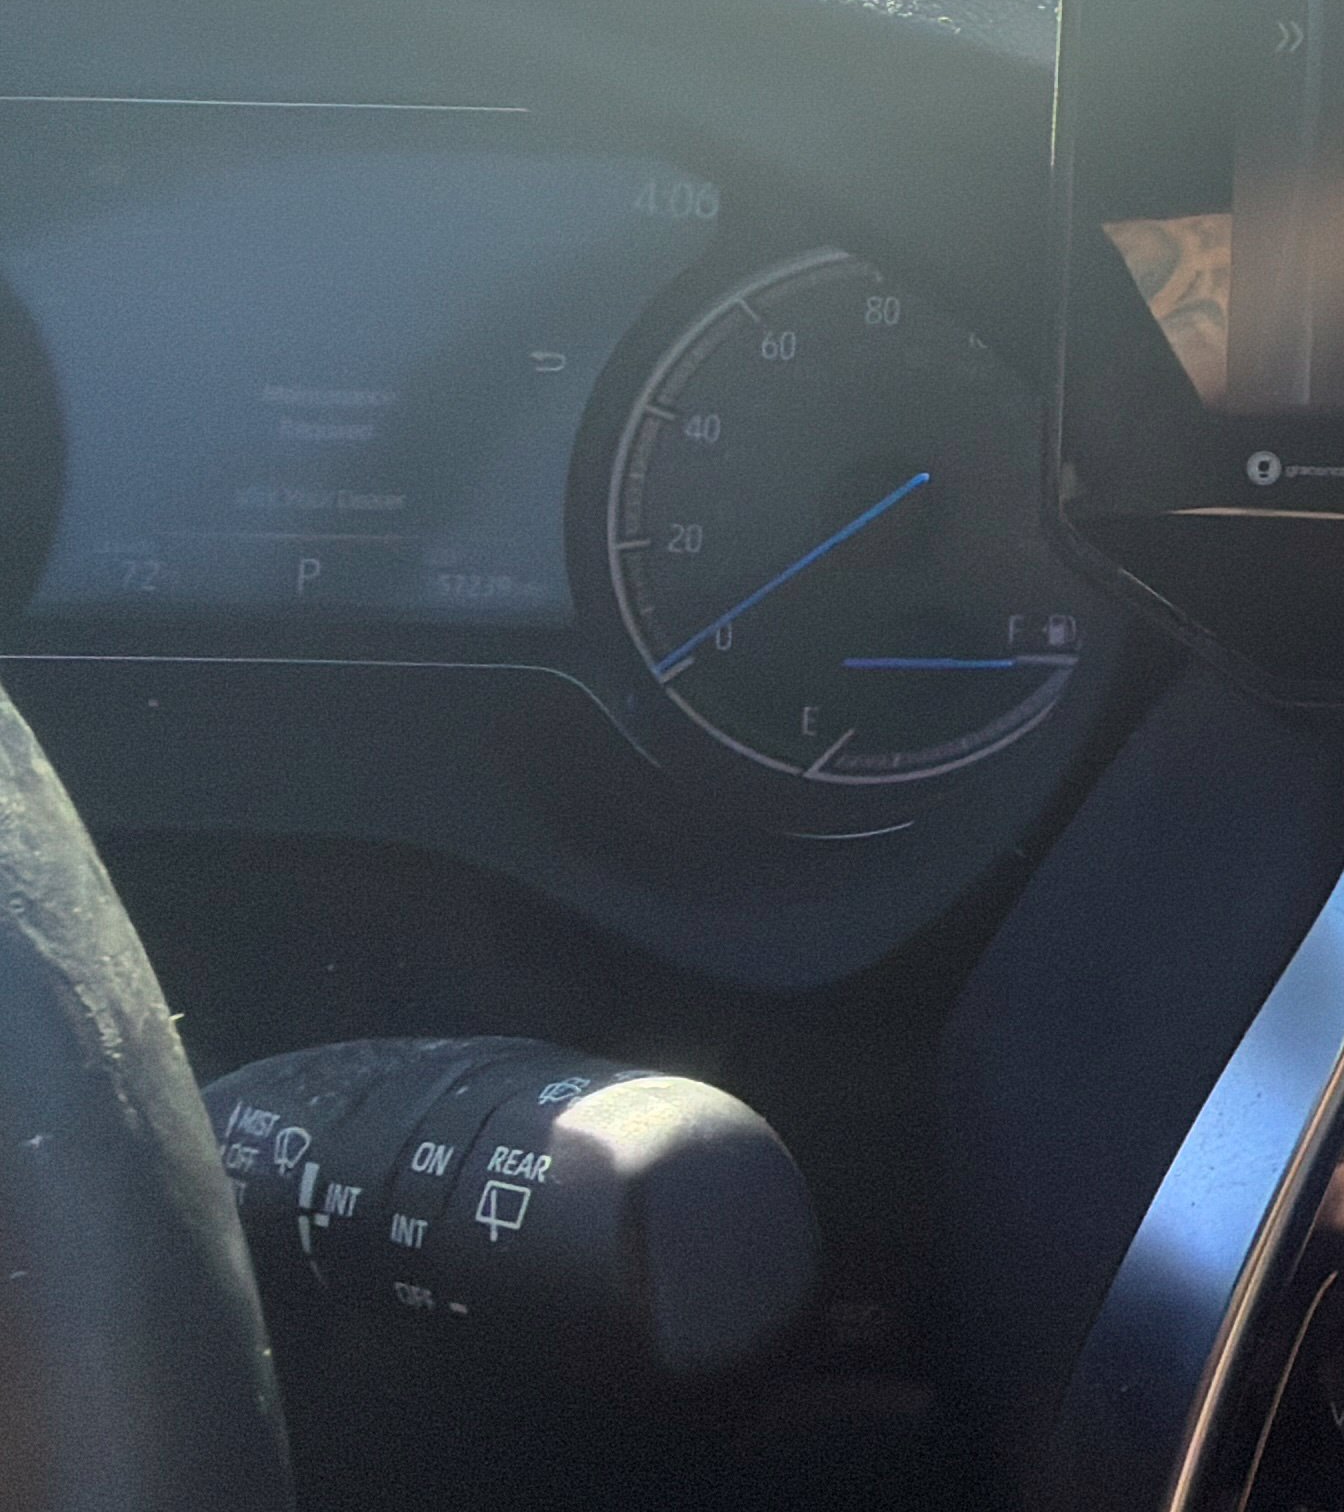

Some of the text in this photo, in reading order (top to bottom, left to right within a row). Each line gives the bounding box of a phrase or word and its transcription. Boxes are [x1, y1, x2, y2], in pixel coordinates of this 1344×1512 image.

[865, 296, 901, 327] 80
[760, 330, 797, 361] 60
[684, 414, 722, 444] 40
[667, 524, 704, 555] 20
[296, 557, 323, 596] P
[714, 619, 735, 653] 0
[1007, 613, 1024, 643] F
[802, 705, 821, 737] E
[411, 1141, 454, 1176] ON
[487, 1146, 552, 1183] REAR
[325, 1182, 362, 1217] INT
[390, 1213, 428, 1248] INT
